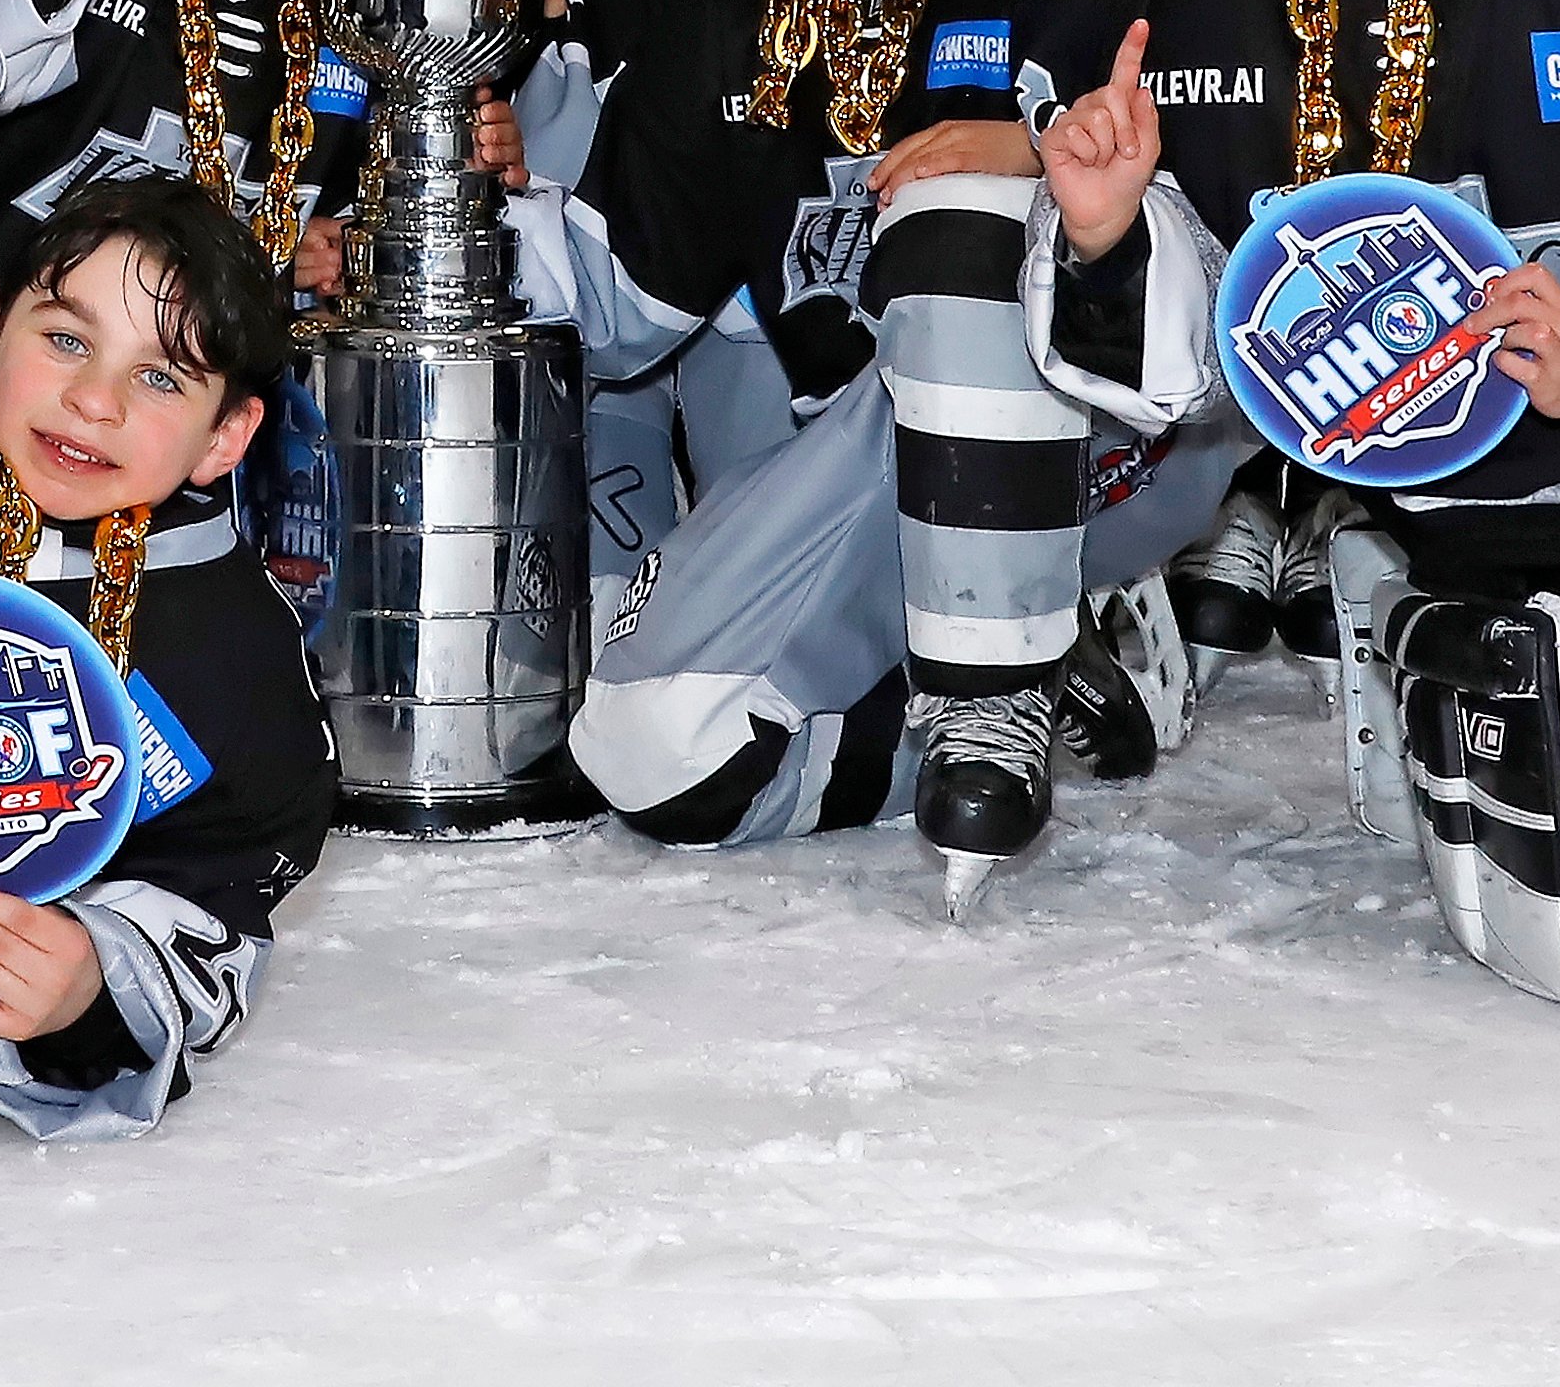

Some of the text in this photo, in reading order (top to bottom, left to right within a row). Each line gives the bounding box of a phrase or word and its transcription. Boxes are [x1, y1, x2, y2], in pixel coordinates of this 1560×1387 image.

[1139, 67, 1264, 105] KLEVR.AI
[1285, 257, 1466, 426] HHOF
[1396, 369, 1461, 424] TORONTO
[134, 705, 194, 803] WENCH
